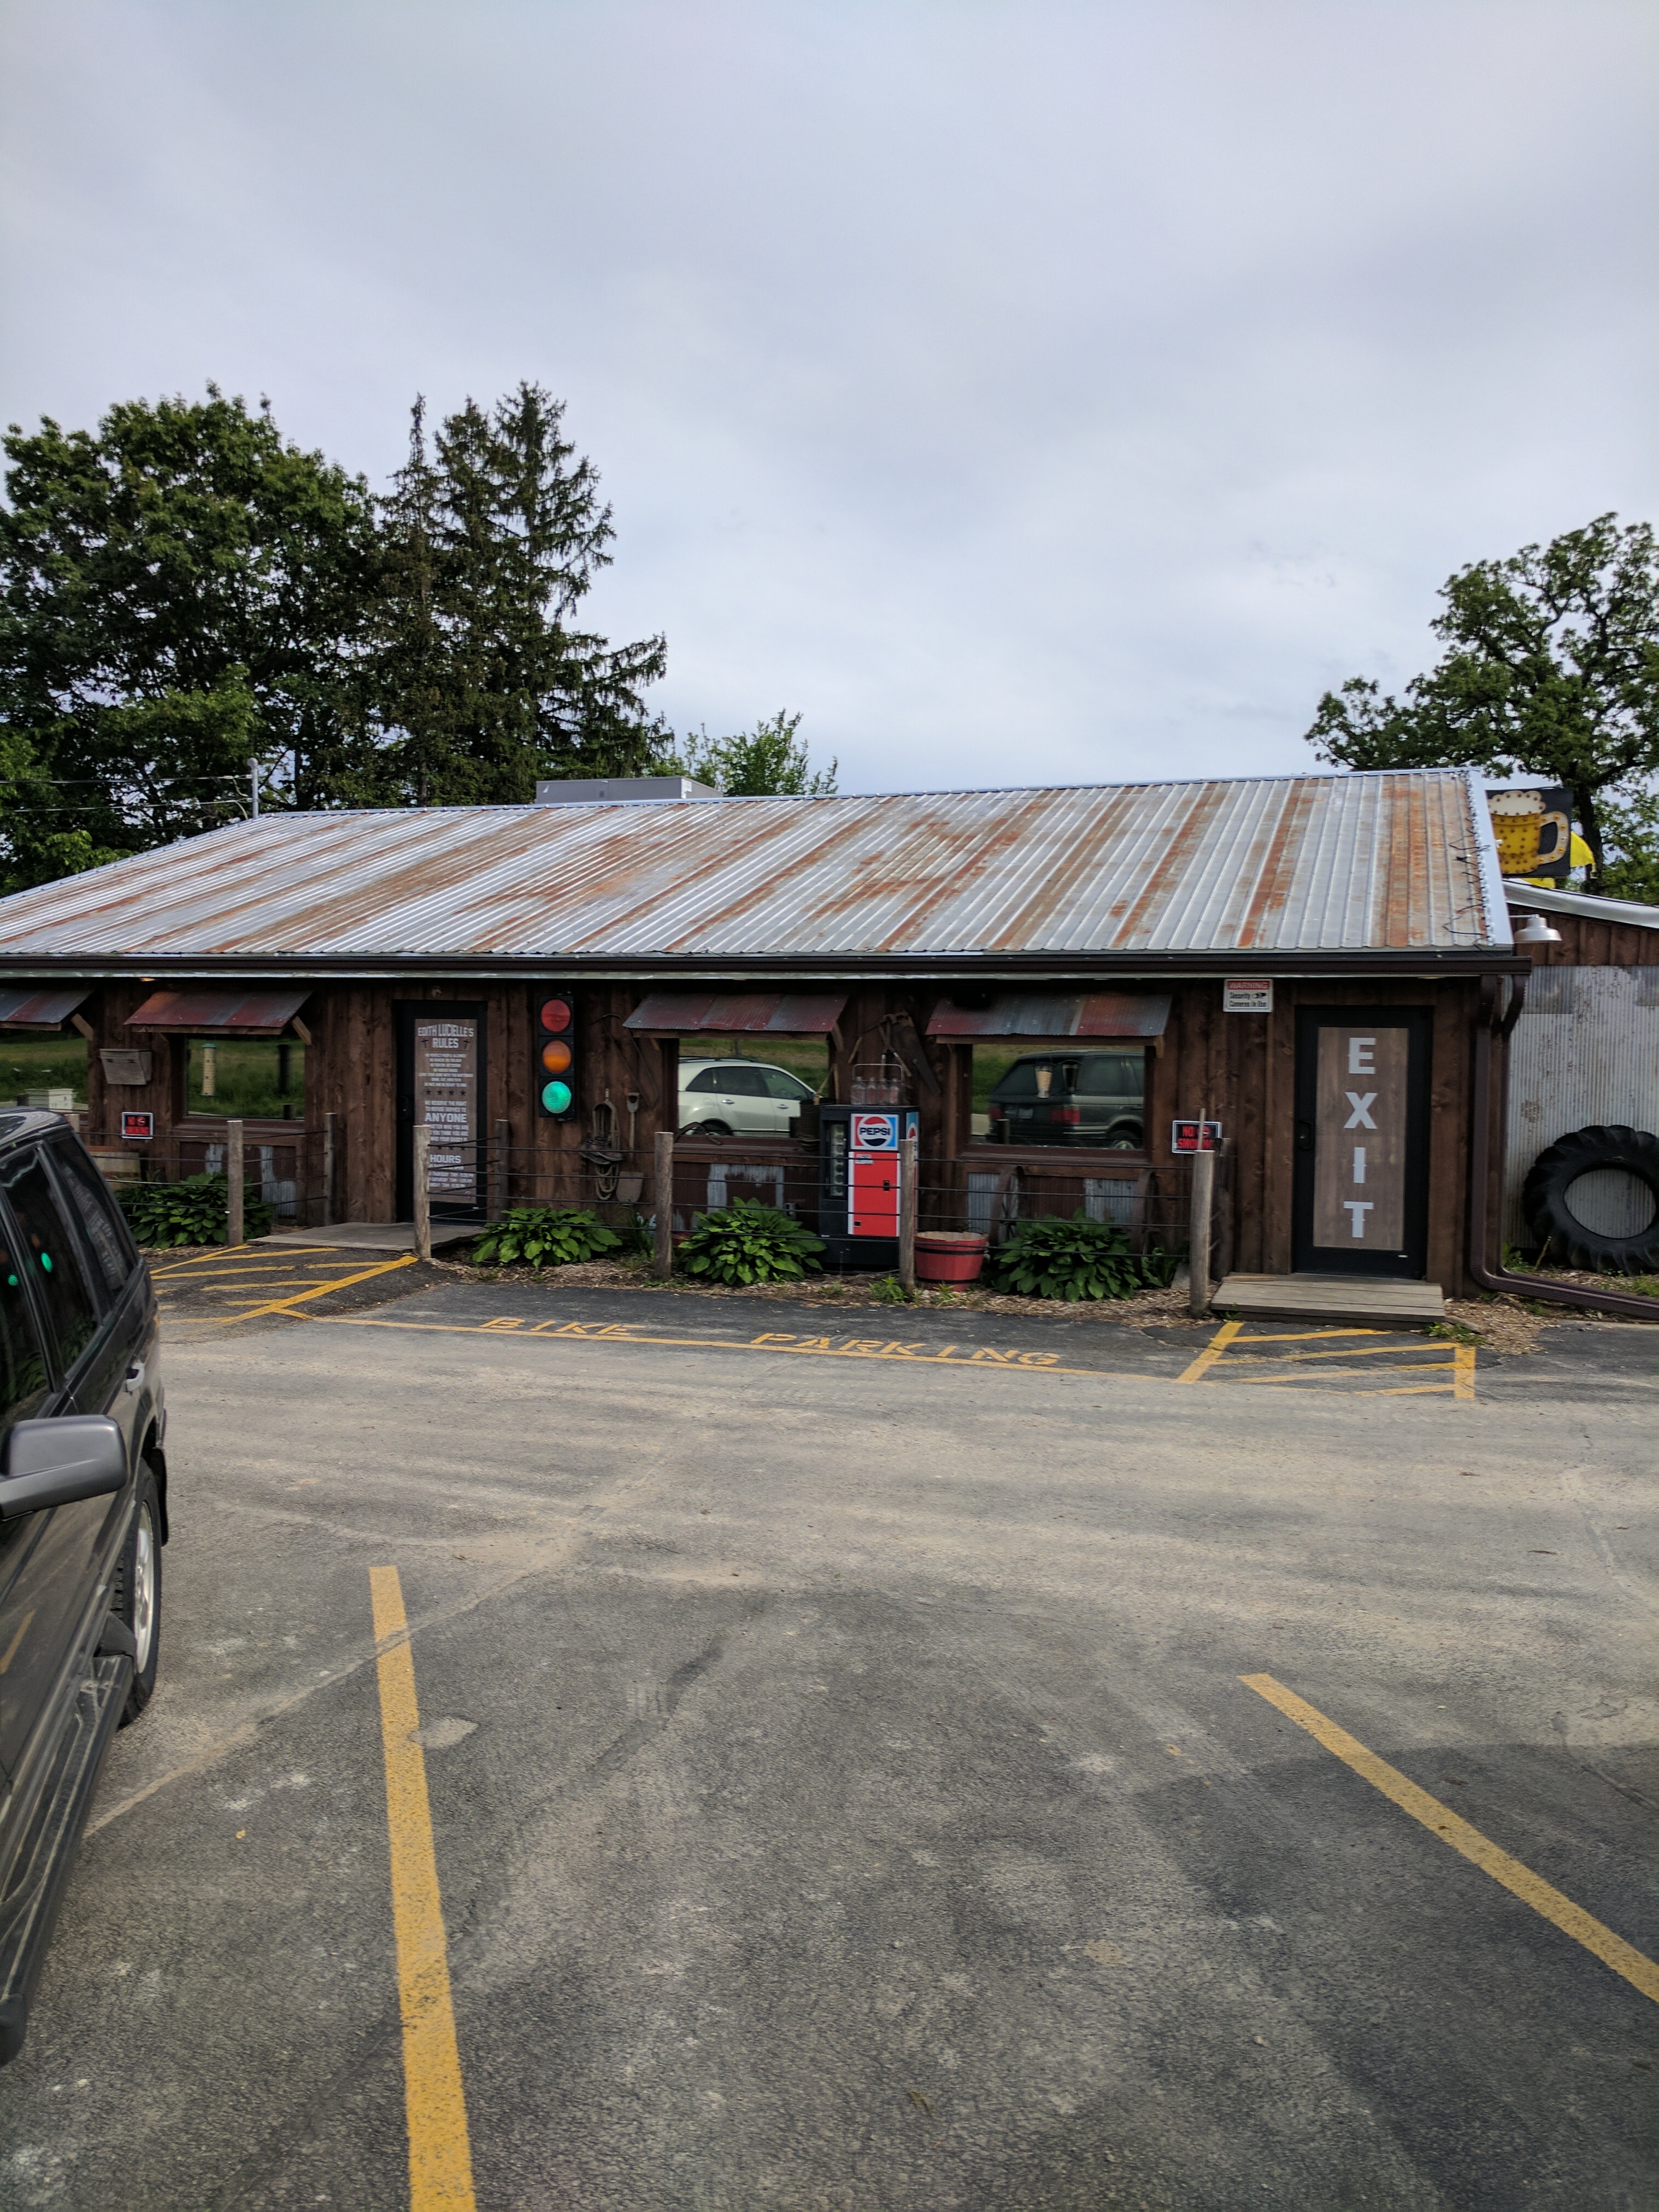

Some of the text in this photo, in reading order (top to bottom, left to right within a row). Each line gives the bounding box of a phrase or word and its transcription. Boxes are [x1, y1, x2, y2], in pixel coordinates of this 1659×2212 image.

[1229, 992, 1250, 1000] Security
[417, 1025, 437, 1037] EDITH
[432, 1038, 459, 1048] RULES
[425, 1113, 467, 1123] ANYONE
[859, 1127, 891, 1136] PEPSI
[1182, 1126, 1195, 1137] NO
[1343, 1037, 1378, 1238] EXIT
[430, 1154, 462, 1163] HOURS
[479, 1316, 1061, 1365] BIKE PARKING
